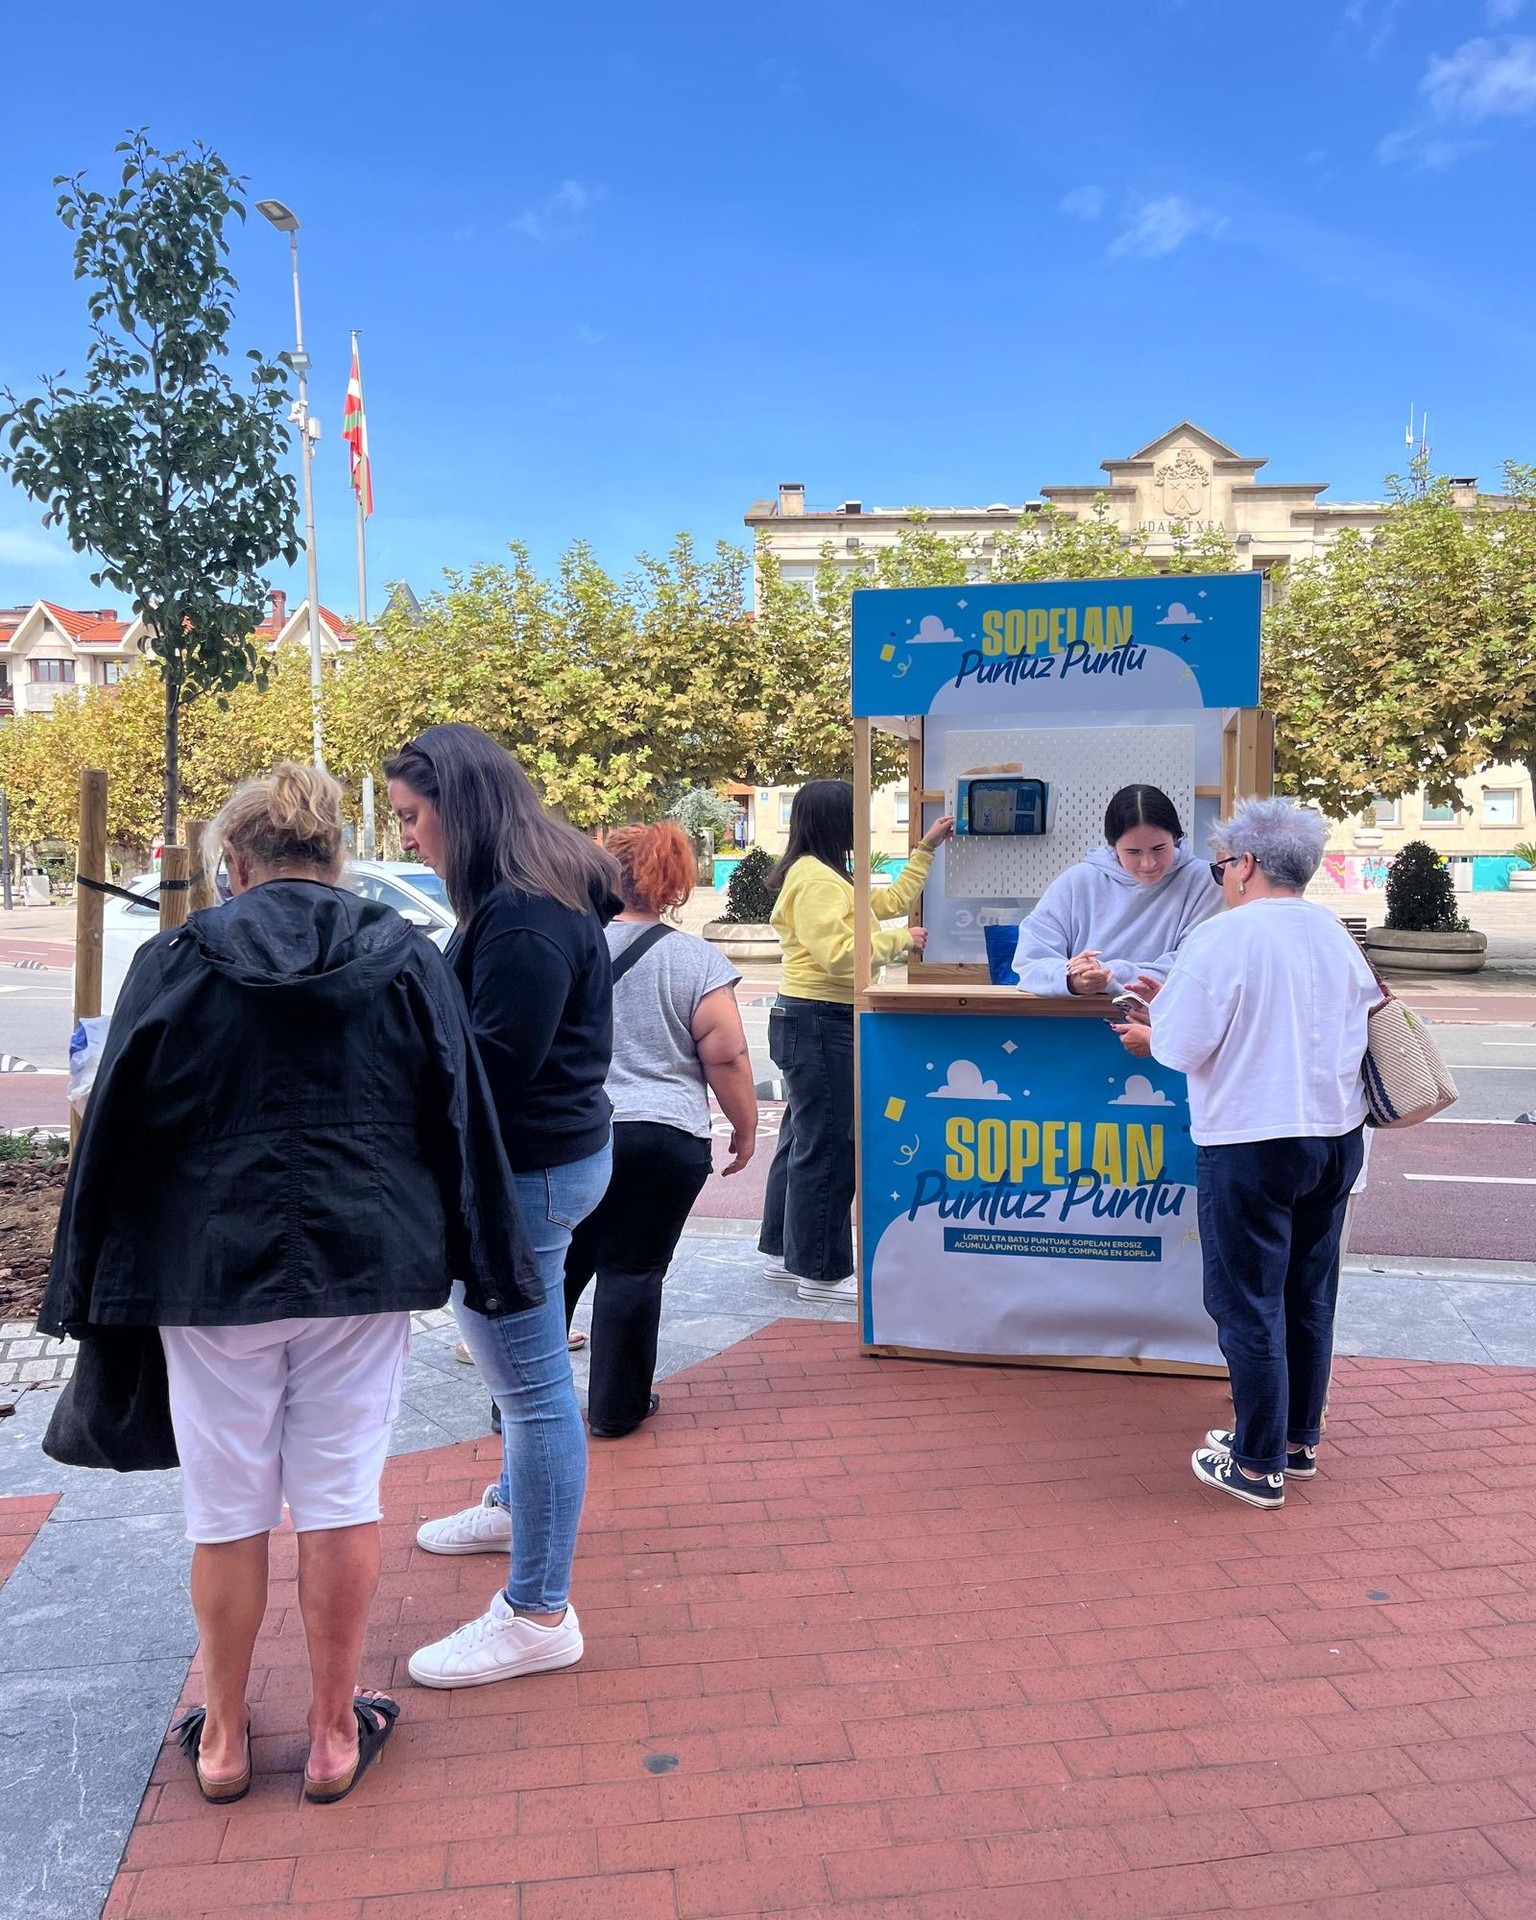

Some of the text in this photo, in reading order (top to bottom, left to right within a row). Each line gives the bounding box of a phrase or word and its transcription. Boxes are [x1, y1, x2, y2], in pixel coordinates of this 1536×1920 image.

[1138, 520, 1225, 533] UDALTXEA
[982, 605, 1133, 657] SOPELAN
[955, 634, 1147, 689] Puntuz Puntu
[945, 1116, 1164, 1187] SOPELAN
[908, 1166, 1187, 1226] Puntuz Puntu
[954, 1241, 1156, 1258] ACUMULA PUNTOS CON TUS COMPRAS EN SOPELA
[963, 1233, 1142, 1249] LORTU ETA BATU PUNTUAK SOPELAN EROSIZ
